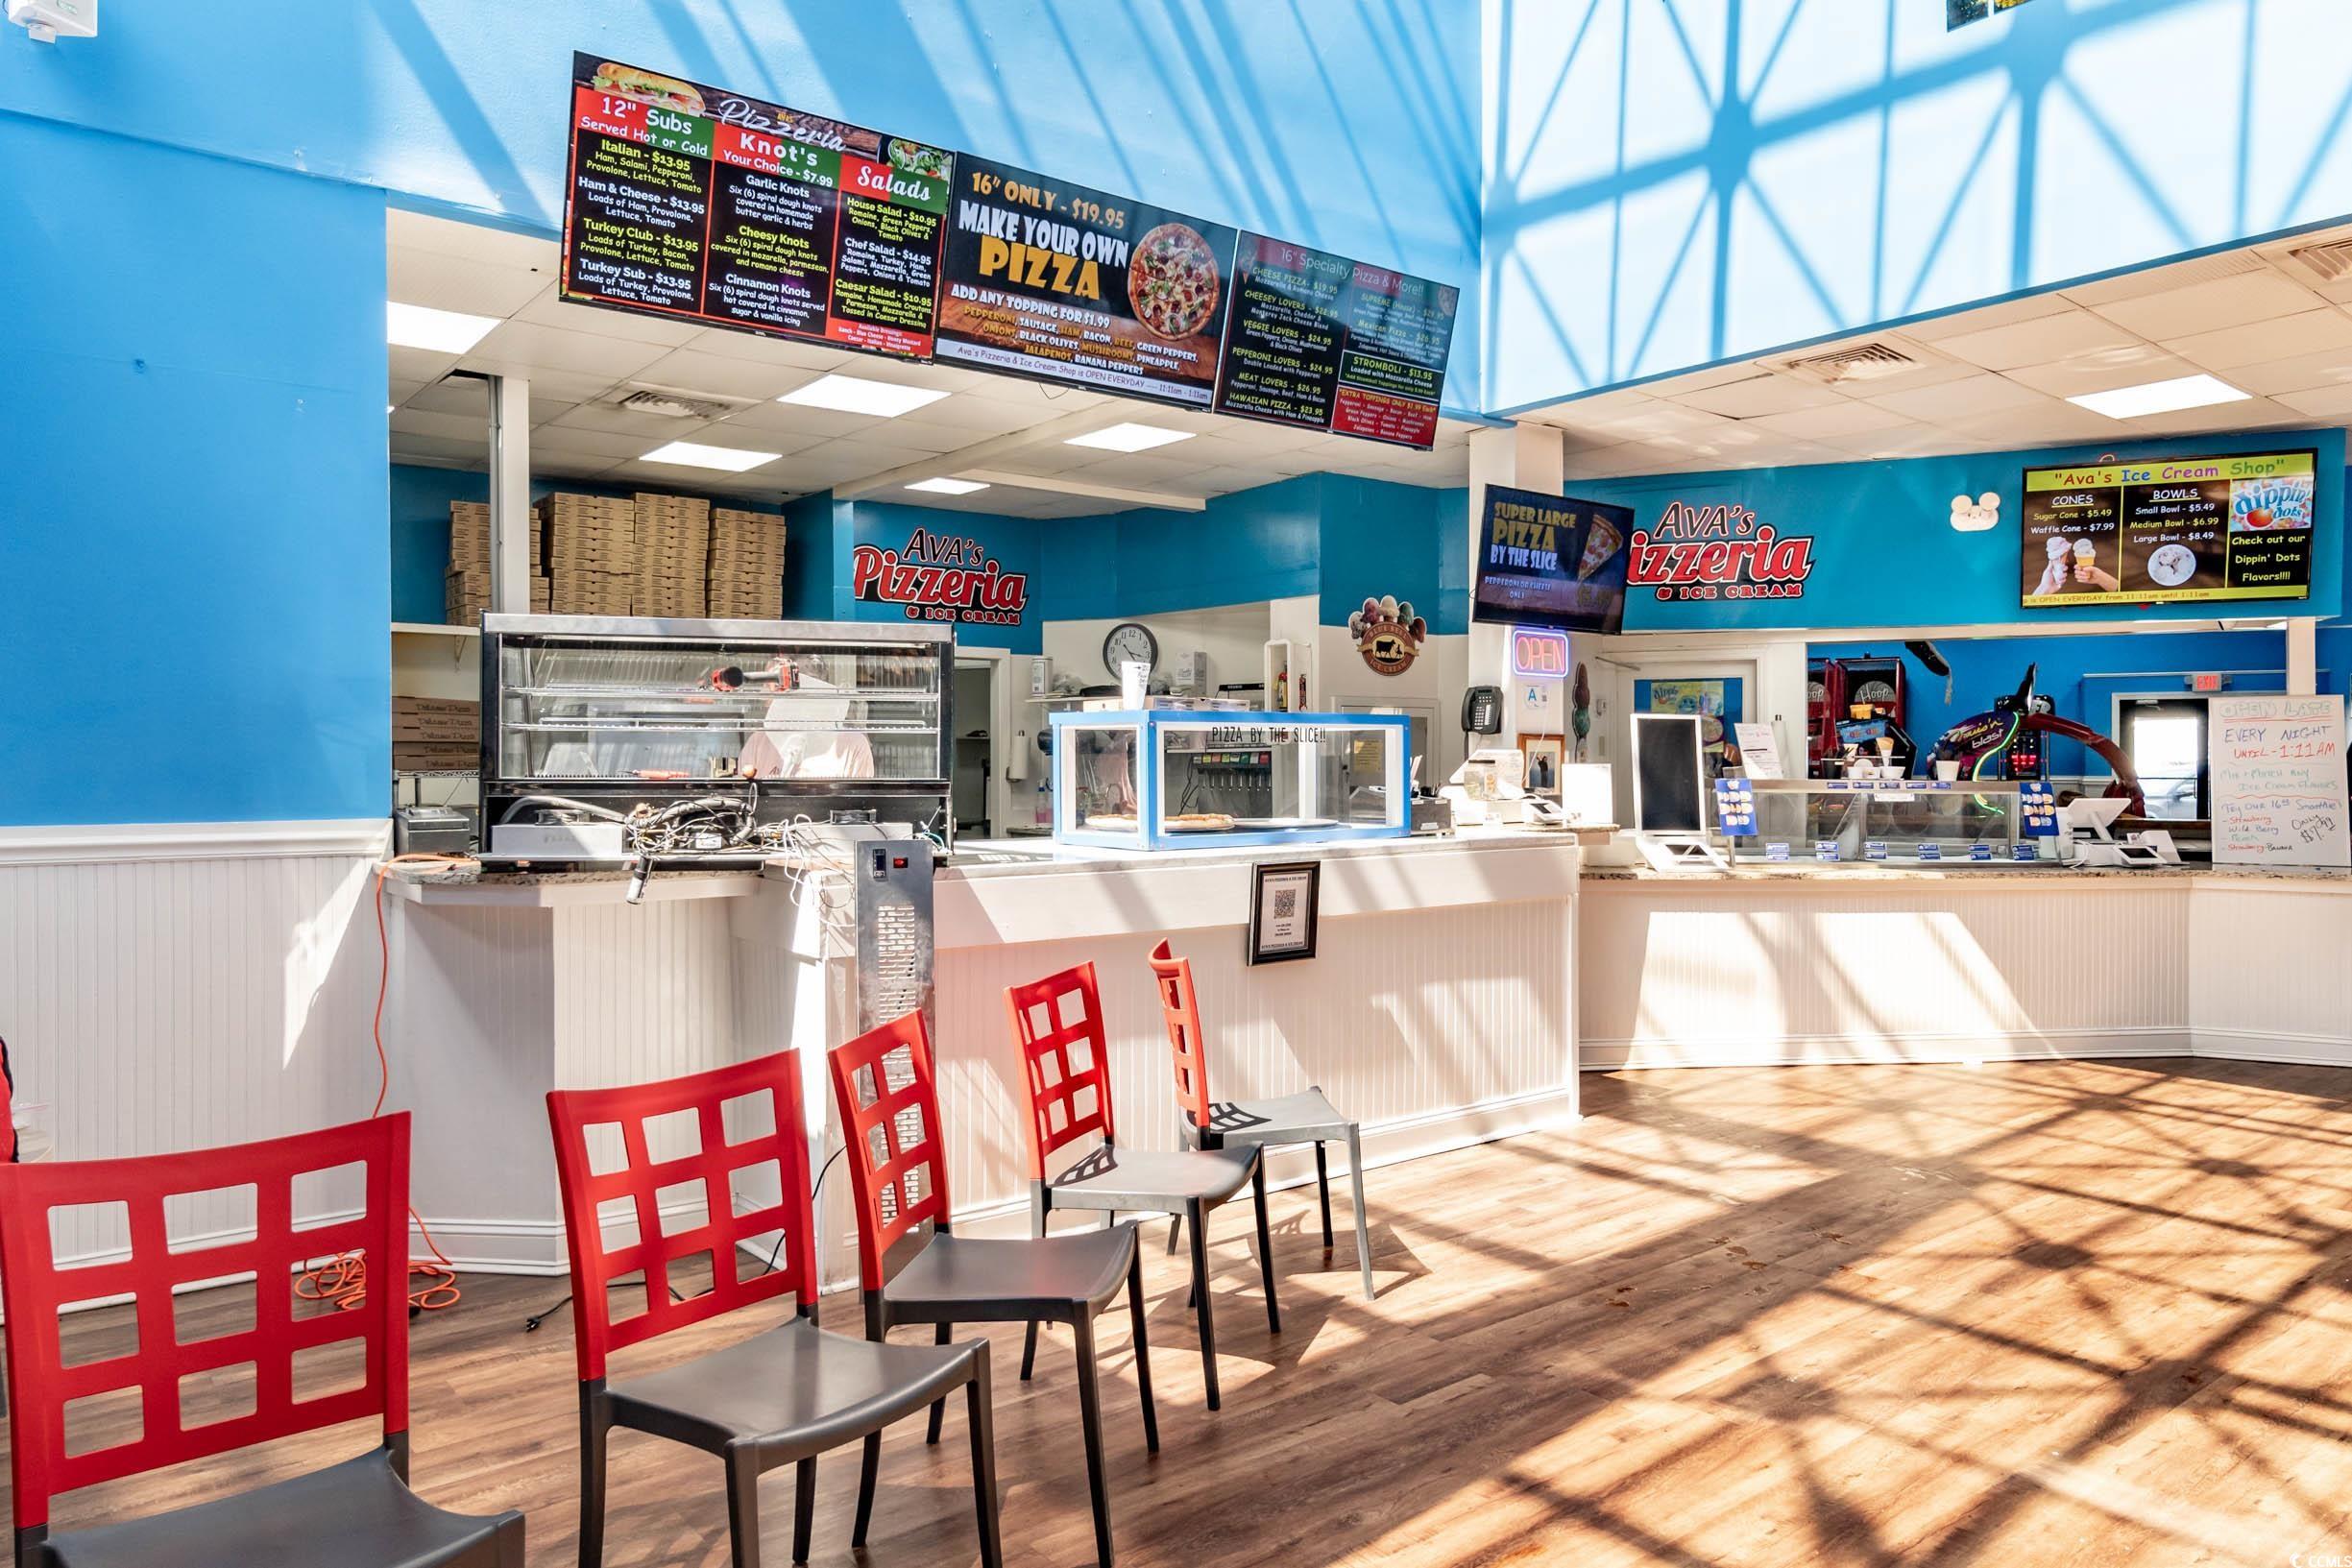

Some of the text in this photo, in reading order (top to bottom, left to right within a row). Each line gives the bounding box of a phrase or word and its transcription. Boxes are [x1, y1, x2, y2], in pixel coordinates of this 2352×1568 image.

[601, 96, 692, 135] 12" Subs
[718, 99, 847, 154] Pizzeria
[580, 115, 707, 157] Served Hot or Cold
[600, 139, 691, 171] Italian $13.95
[740, 133, 818, 167] Knot's
[586, 160, 701, 193] Provolone, Lettuce, Tomato
[594, 152, 694, 183] Ham, Salami, Pepperoni,
[722, 150, 833, 187] Your Choice $7.99
[578, 177, 705, 214] Ham & Cheese $13.95
[745, 174, 810, 198] Garlic Knots
[857, 166, 932, 203] Salads
[728, 184, 822, 213] Six (6) spiral dough knots
[847, 197, 936, 227] House Salad $10.95
[971, 171, 1125, 229] 16" ONLY $19.95
[583, 217, 698, 252] Turkey Club $13.95
[739, 225, 810, 249] Cheesy Knots
[958, 200, 1129, 269] MAKE YOUR OWN
[844, 236, 932, 265] Chef Salad $14.95
[580, 258, 691, 289] Turkey Sub $13.95
[980, 235, 1101, 300] PIZZA
[1281, 248, 1423, 296] 16" Specialty Pizza & More!!
[725, 273, 811, 299] Cinnamon Knots
[951, 284, 1110, 328] ADD ANY TOPPING FOR $1.99
[1019, 329, 1079, 350] BLACK OLIVES,
[1243, 319, 1331, 346] VEGGIE LOVERS $24.95
[1136, 340, 1199, 362] GREEN PEPPERS,
[1232, 346, 1333, 374] PEPPERONI LOVERS $24.95
[1352, 356, 1432, 380] STROMBOLI $13.95
[1228, 392, 1322, 416] HAWAIIAN PIZZA $23.95
[2054, 459, 2284, 486] "Ava's Ice Cream Shop"
[2052, 494, 2093, 505] CONES
[2153, 488, 2197, 499] BOWLS
[1493, 501, 1576, 528] SUPER LARGE
[2033, 512, 2056, 520] Sugar
[2087, 508, 2112, 518] $5.49
[2135, 502, 2215, 515] Small Bowl $5.49
[2272, 504, 2302, 520] dots
[1491, 519, 1556, 551] PIZZA
[2030, 522, 2114, 534] Waffle Cone $7.99
[2129, 517, 2219, 529] Medium Bowl $6.99
[2133, 531, 2214, 544] Large Bowl $8.49
[2231, 534, 2306, 545] Check out our
[1490, 543, 1557, 570] BY THE SLICE
[1627, 524, 1813, 585] izzeria
[2235, 552, 2300, 566] Dippin' Dots
[854, 545, 1027, 611] Pizzeria
[1680, 586, 1717, 599] ICE
[1726, 583, 1803, 599] CREAM
[926, 606, 956, 620] ICE
[961, 610, 1020, 624] CREAM
[1516, 636, 1565, 673] OPEN
[1528, 688, 1537, 701] A
[1212, 726, 1326, 742] PIZZA BY THE SLICE!!
[1972, 729, 2004, 749] blast
[2224, 726, 2334, 743] EVERY NIGHT
